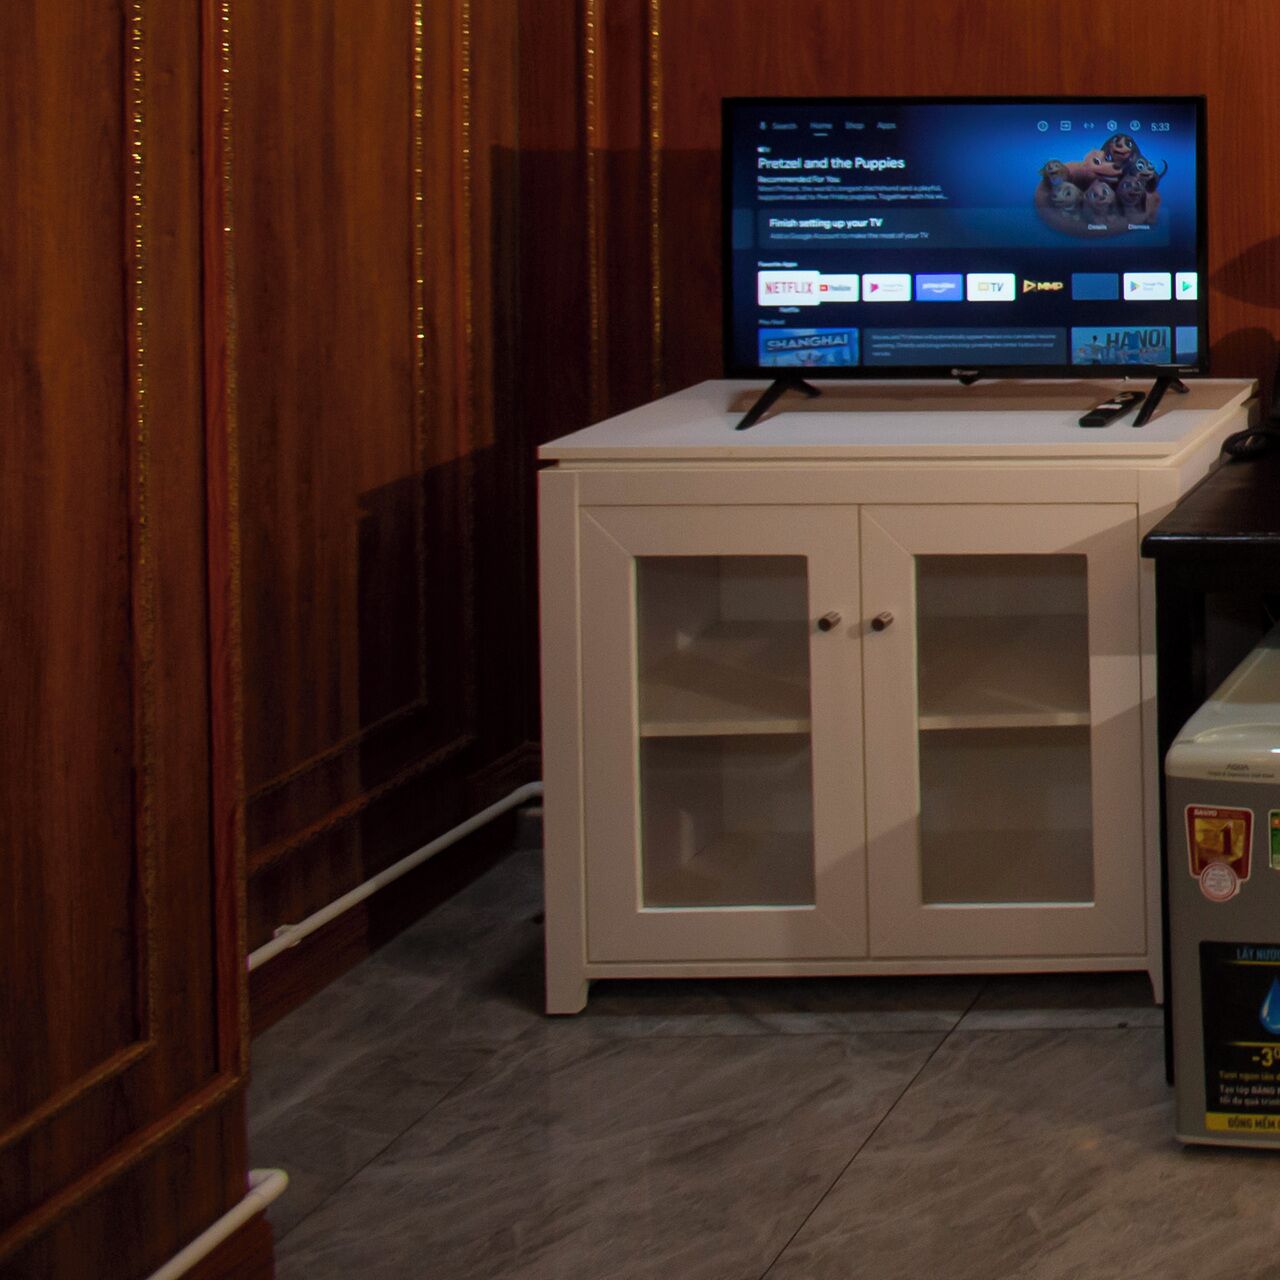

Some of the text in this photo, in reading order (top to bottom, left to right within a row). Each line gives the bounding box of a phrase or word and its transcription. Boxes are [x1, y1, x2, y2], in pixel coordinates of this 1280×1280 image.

[758, 157, 906, 171] Pretzel and the Puppies
[769, 218, 884, 230] Finish setting up your TV
[764, 281, 814, 294] NETFLIX
[990, 282, 1005, 293] TV
[767, 334, 849, 351] SHANGHAI
